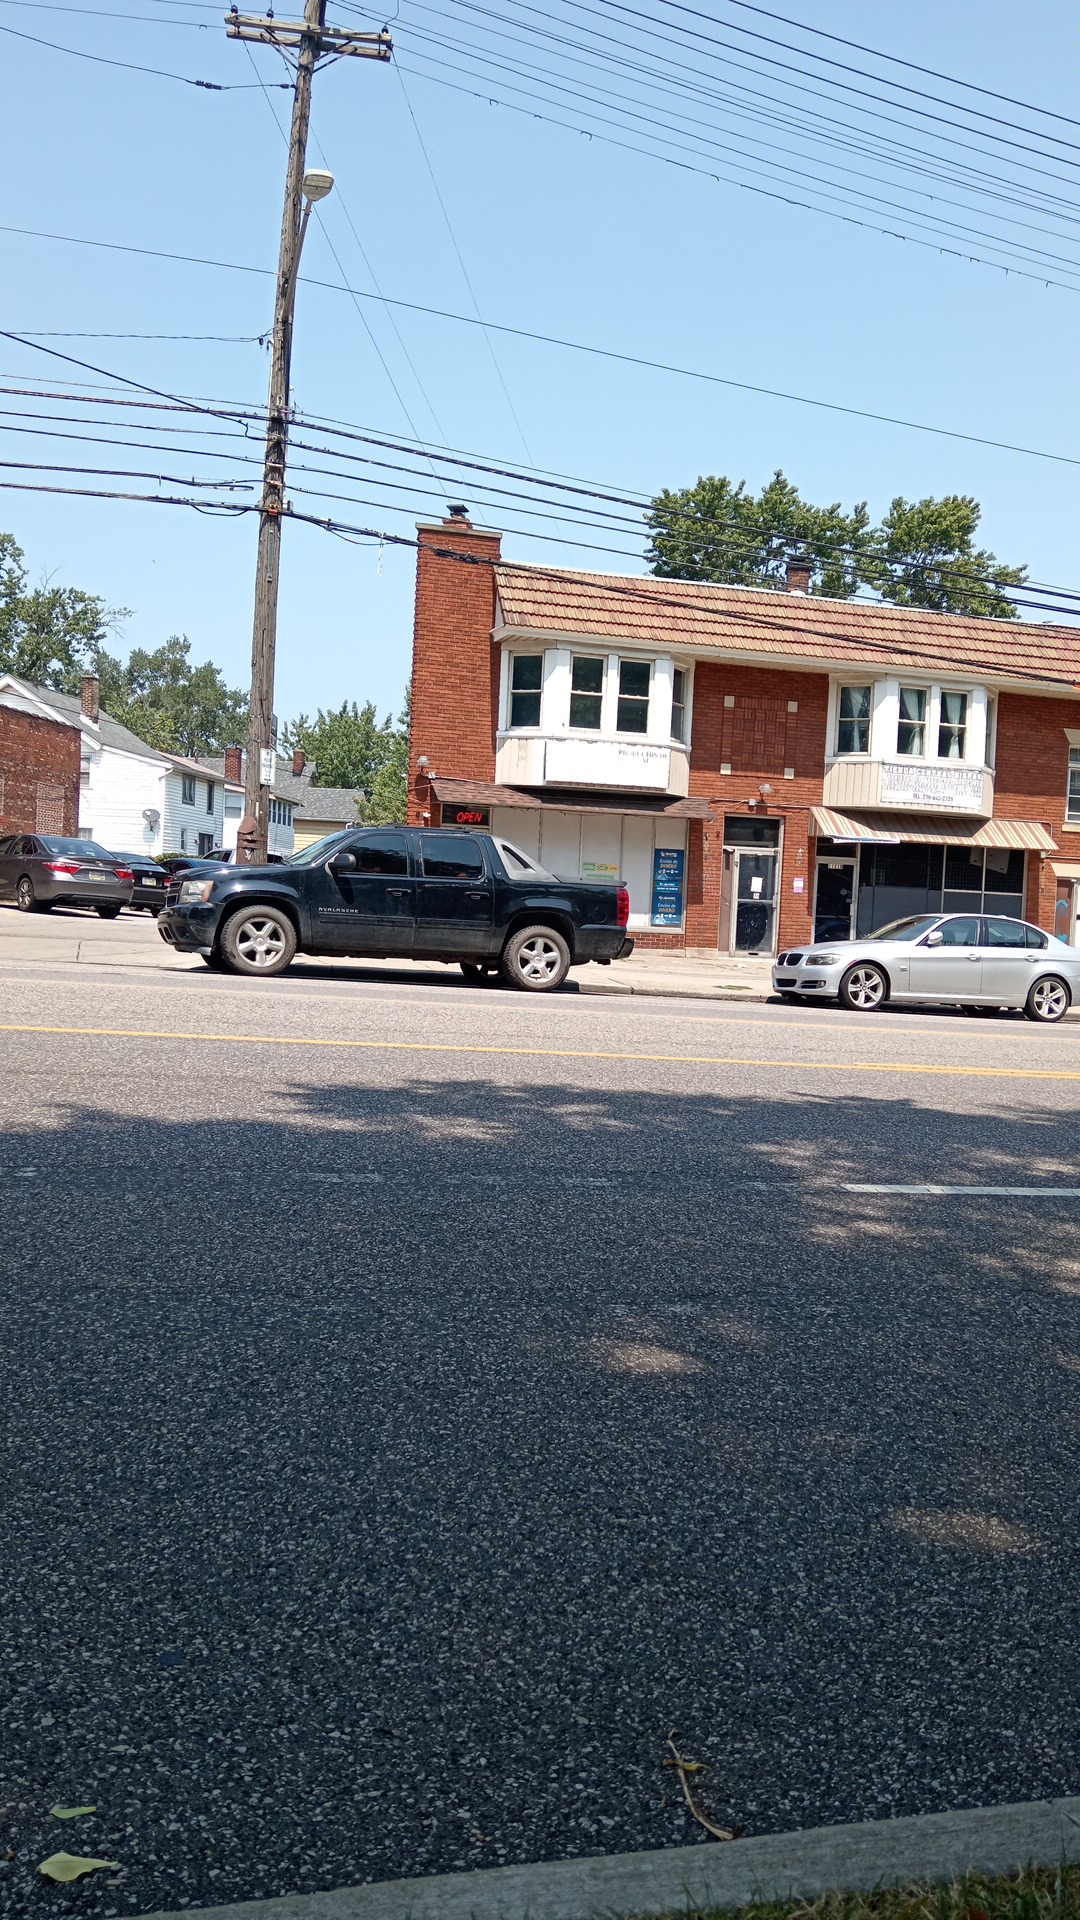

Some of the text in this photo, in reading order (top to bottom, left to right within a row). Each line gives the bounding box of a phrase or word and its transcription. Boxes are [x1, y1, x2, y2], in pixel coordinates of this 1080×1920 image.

[884, 765, 915, 775] TIENDA
[915, 767, 953, 778] CENTRAL
[456, 811, 482, 823] OPEN
